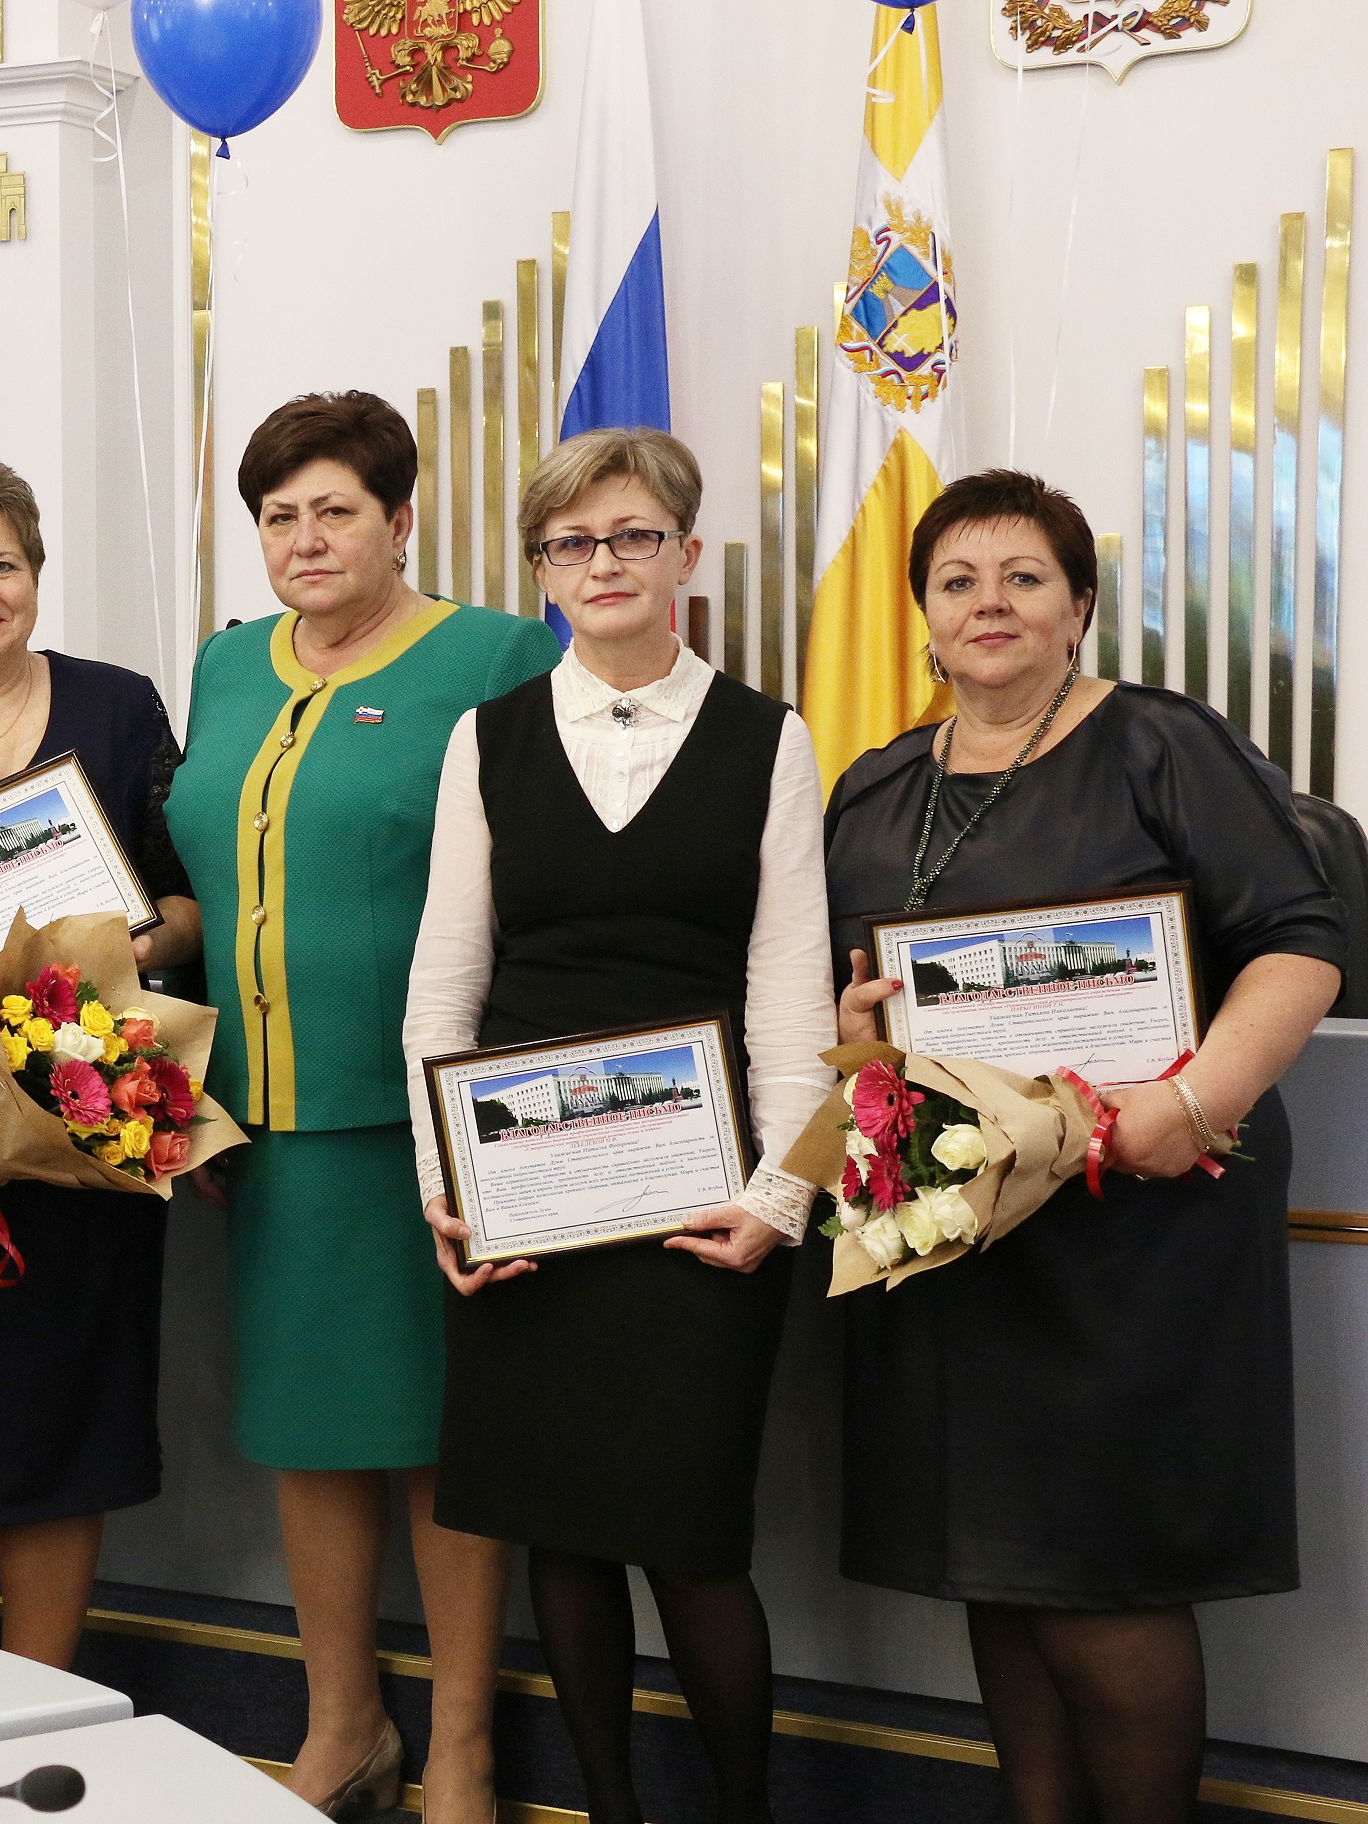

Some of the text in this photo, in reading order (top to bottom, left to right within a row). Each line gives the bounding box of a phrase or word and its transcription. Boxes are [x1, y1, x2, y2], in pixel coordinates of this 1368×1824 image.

[938, 980, 1074, 1005] БЛАГОДАРСТВЕННОЕ
[1077, 973, 1135, 990] ПИСЬМО
[500, 1111, 624, 1141] БЛАГОДАРСТВЕННОЕ
[629, 1102, 681, 1120] ПИСЬМО
